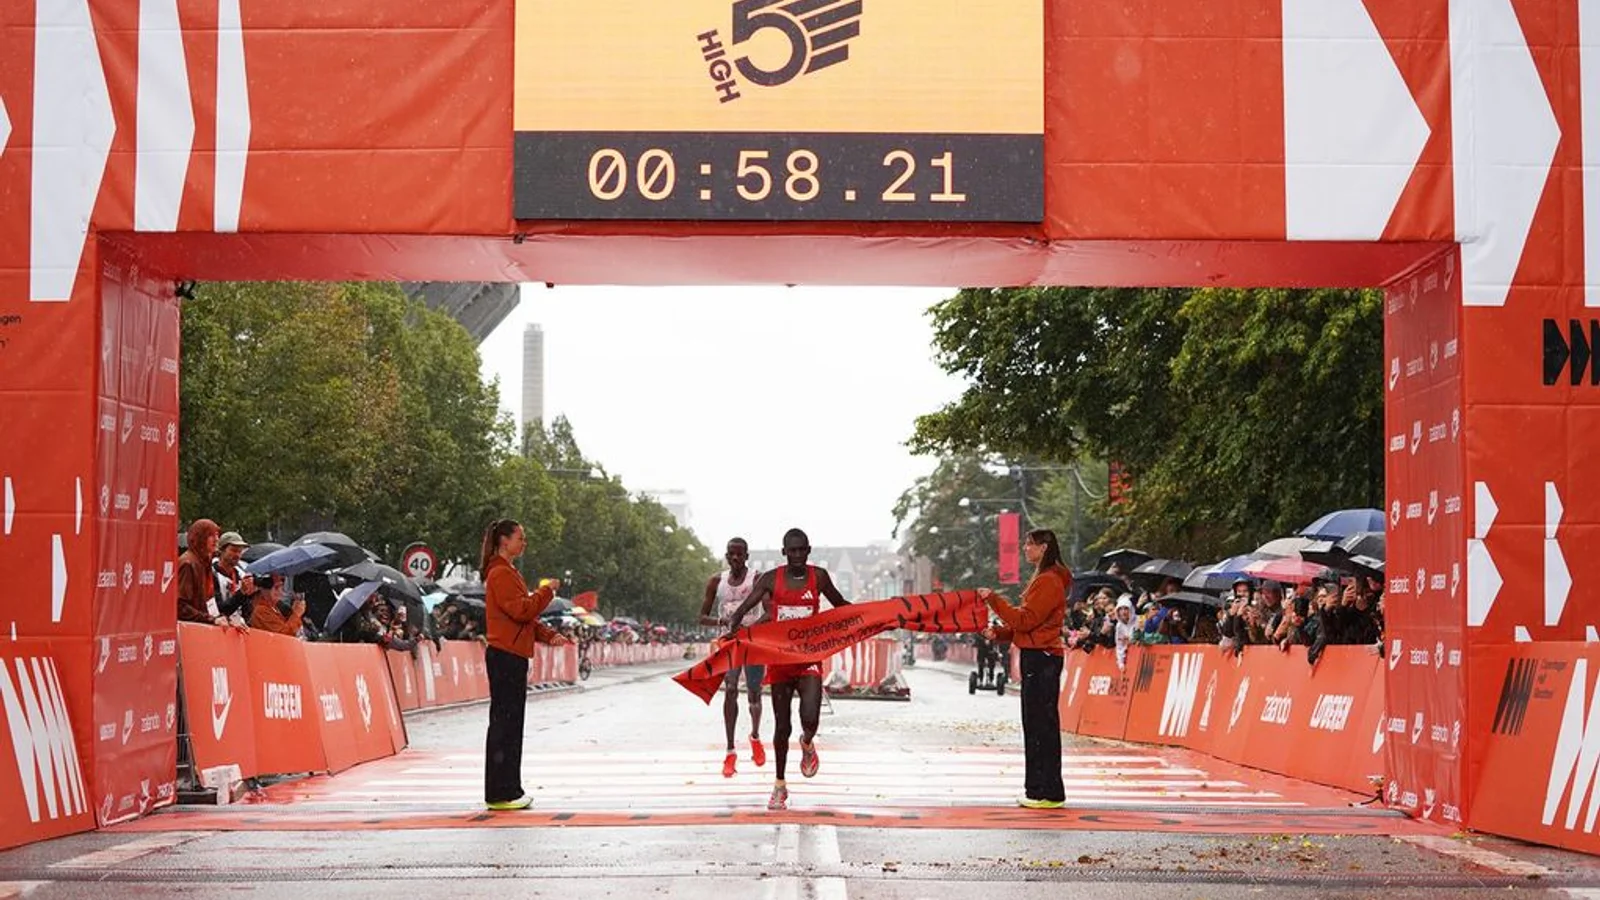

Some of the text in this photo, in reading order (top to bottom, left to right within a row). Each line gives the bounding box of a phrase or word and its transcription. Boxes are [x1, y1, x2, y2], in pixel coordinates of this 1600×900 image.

[697, 29, 741, 104] HIGH
[0, 315, 21, 326] gen
[410, 557, 429, 570] 40
[788, 614, 865, 641] Copenhagen
